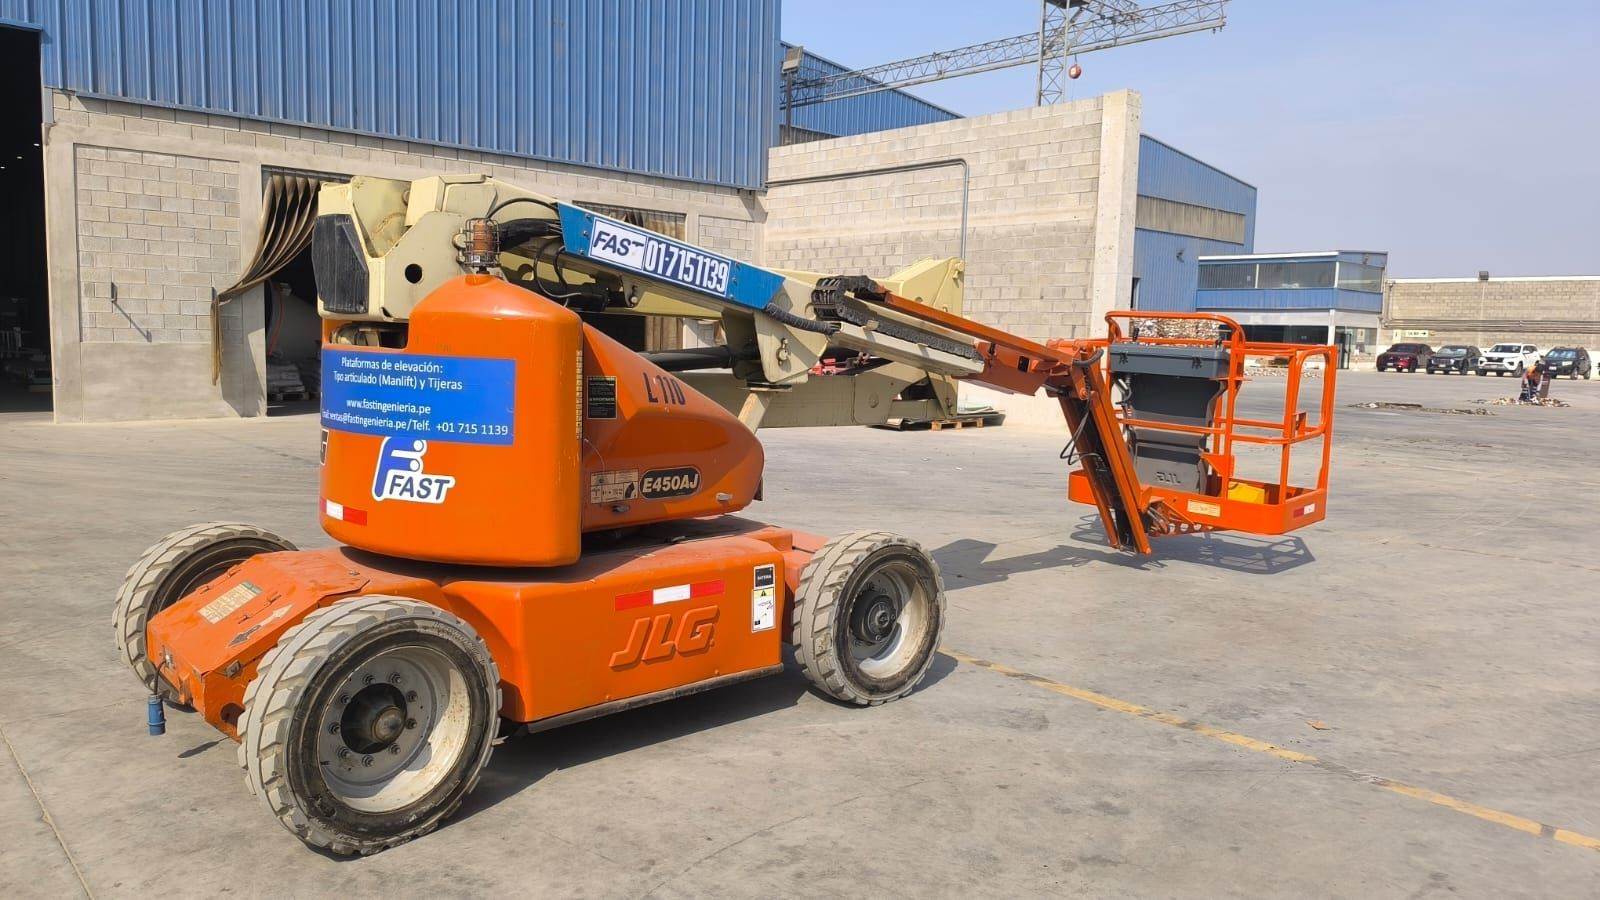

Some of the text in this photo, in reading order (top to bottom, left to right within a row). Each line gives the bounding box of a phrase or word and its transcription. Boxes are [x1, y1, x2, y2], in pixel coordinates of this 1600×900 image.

[644, 239, 729, 293] 01-7151139
[341, 356, 443, 373] Plataformas de elevación:
[344, 372, 377, 385] articulado
[379, 374, 417, 390] (Manlift)
[419, 379, 426, 391] y
[428, 377, 463, 391] Tijeras
[346, 398, 431, 416] www.fastingenieria.pe
[436, 421, 455, 433] +01
[458, 422, 478, 434] 715
[481, 424, 509, 436] 1139
[388, 474, 451, 500] FAST
[642, 474, 699, 494] E450AJ
[608, 604, 721, 673] JLG
